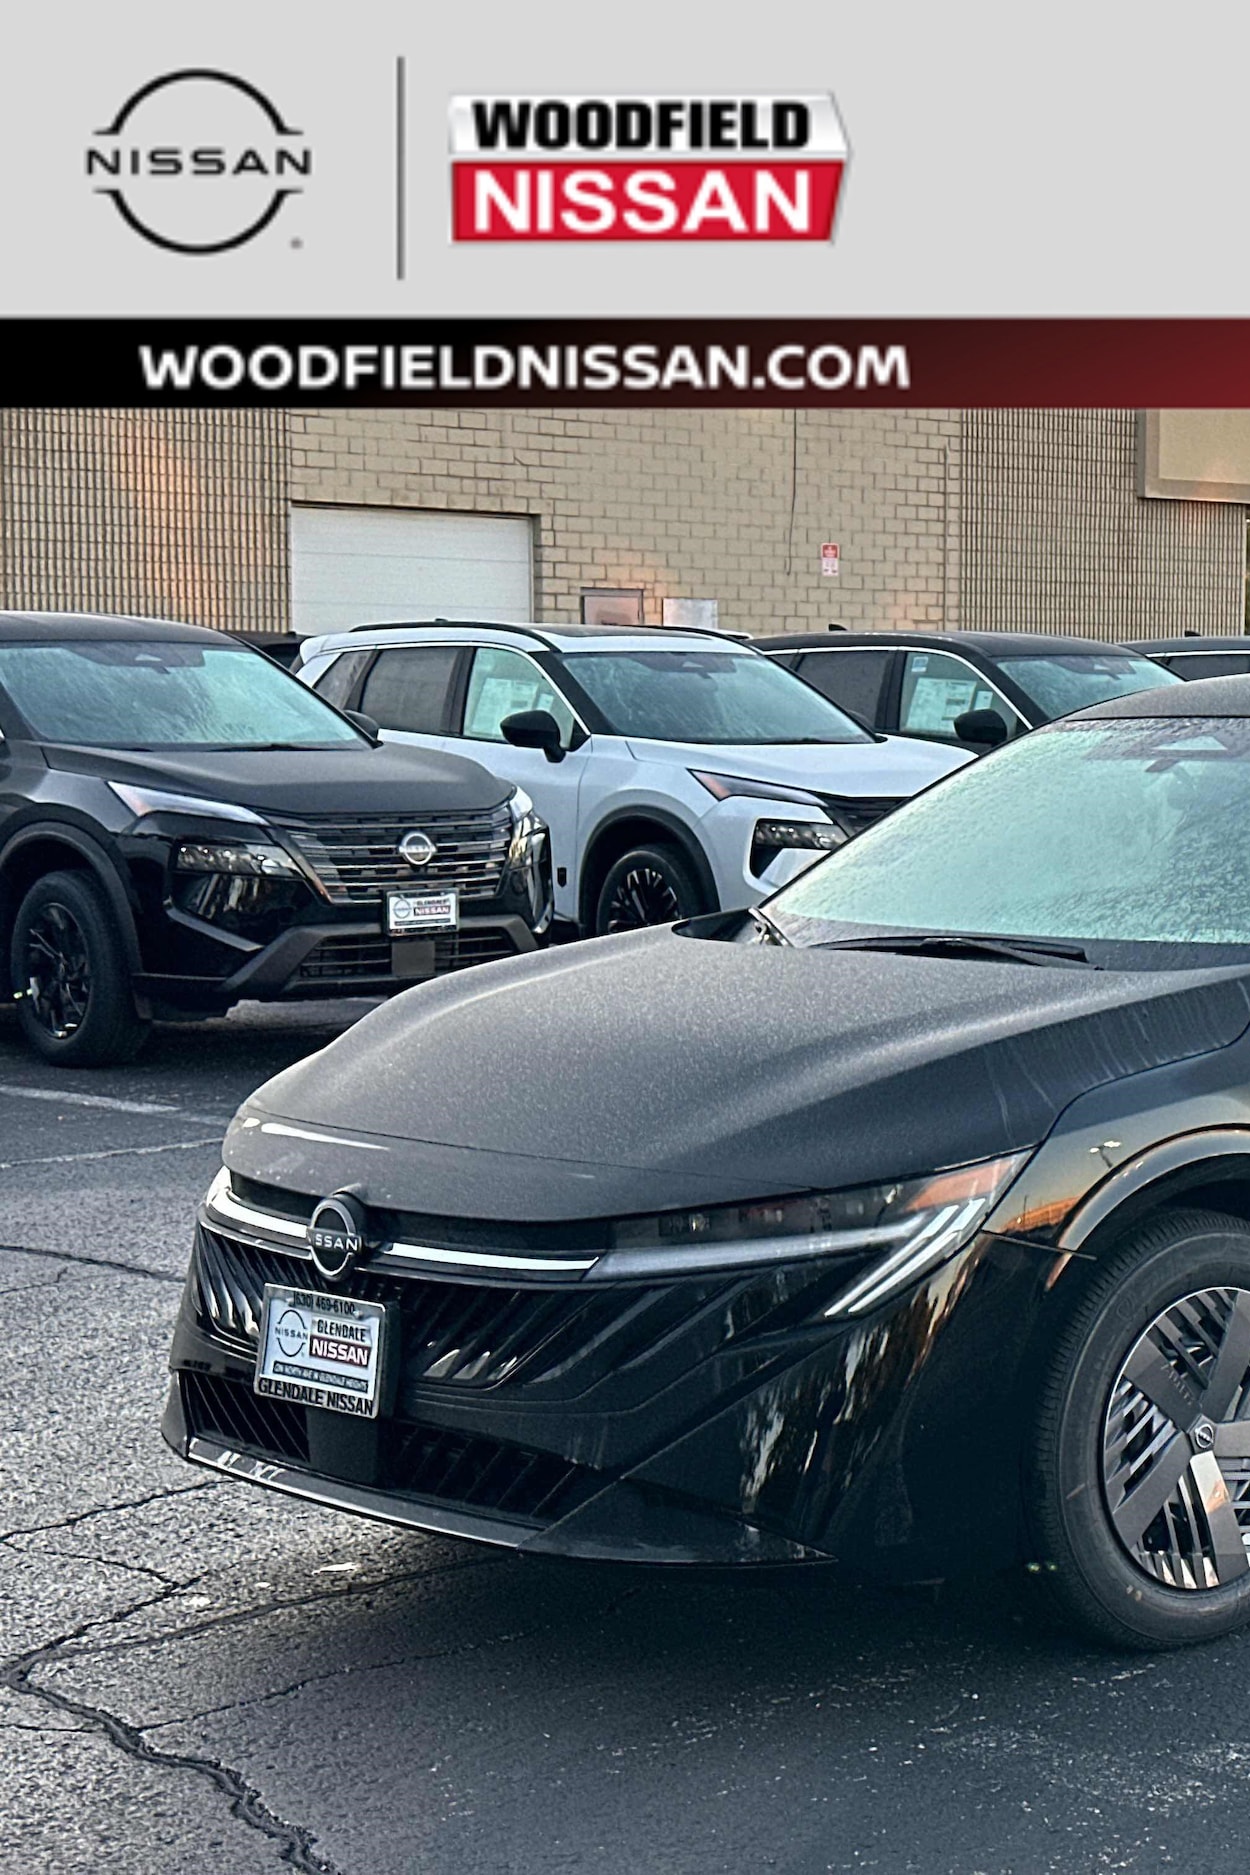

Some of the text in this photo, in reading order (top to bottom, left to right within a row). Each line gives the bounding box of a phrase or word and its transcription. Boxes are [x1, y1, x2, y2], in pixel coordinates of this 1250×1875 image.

[414, 906, 449, 915] NISSAN
[312, 1232, 358, 1251] SSAN
[274, 1326, 308, 1340] NISSAN
[317, 1319, 367, 1342] GLENDALE
[311, 1338, 368, 1366] NISSAN
[259, 1378, 374, 1416] GLENDALE NISSAN
